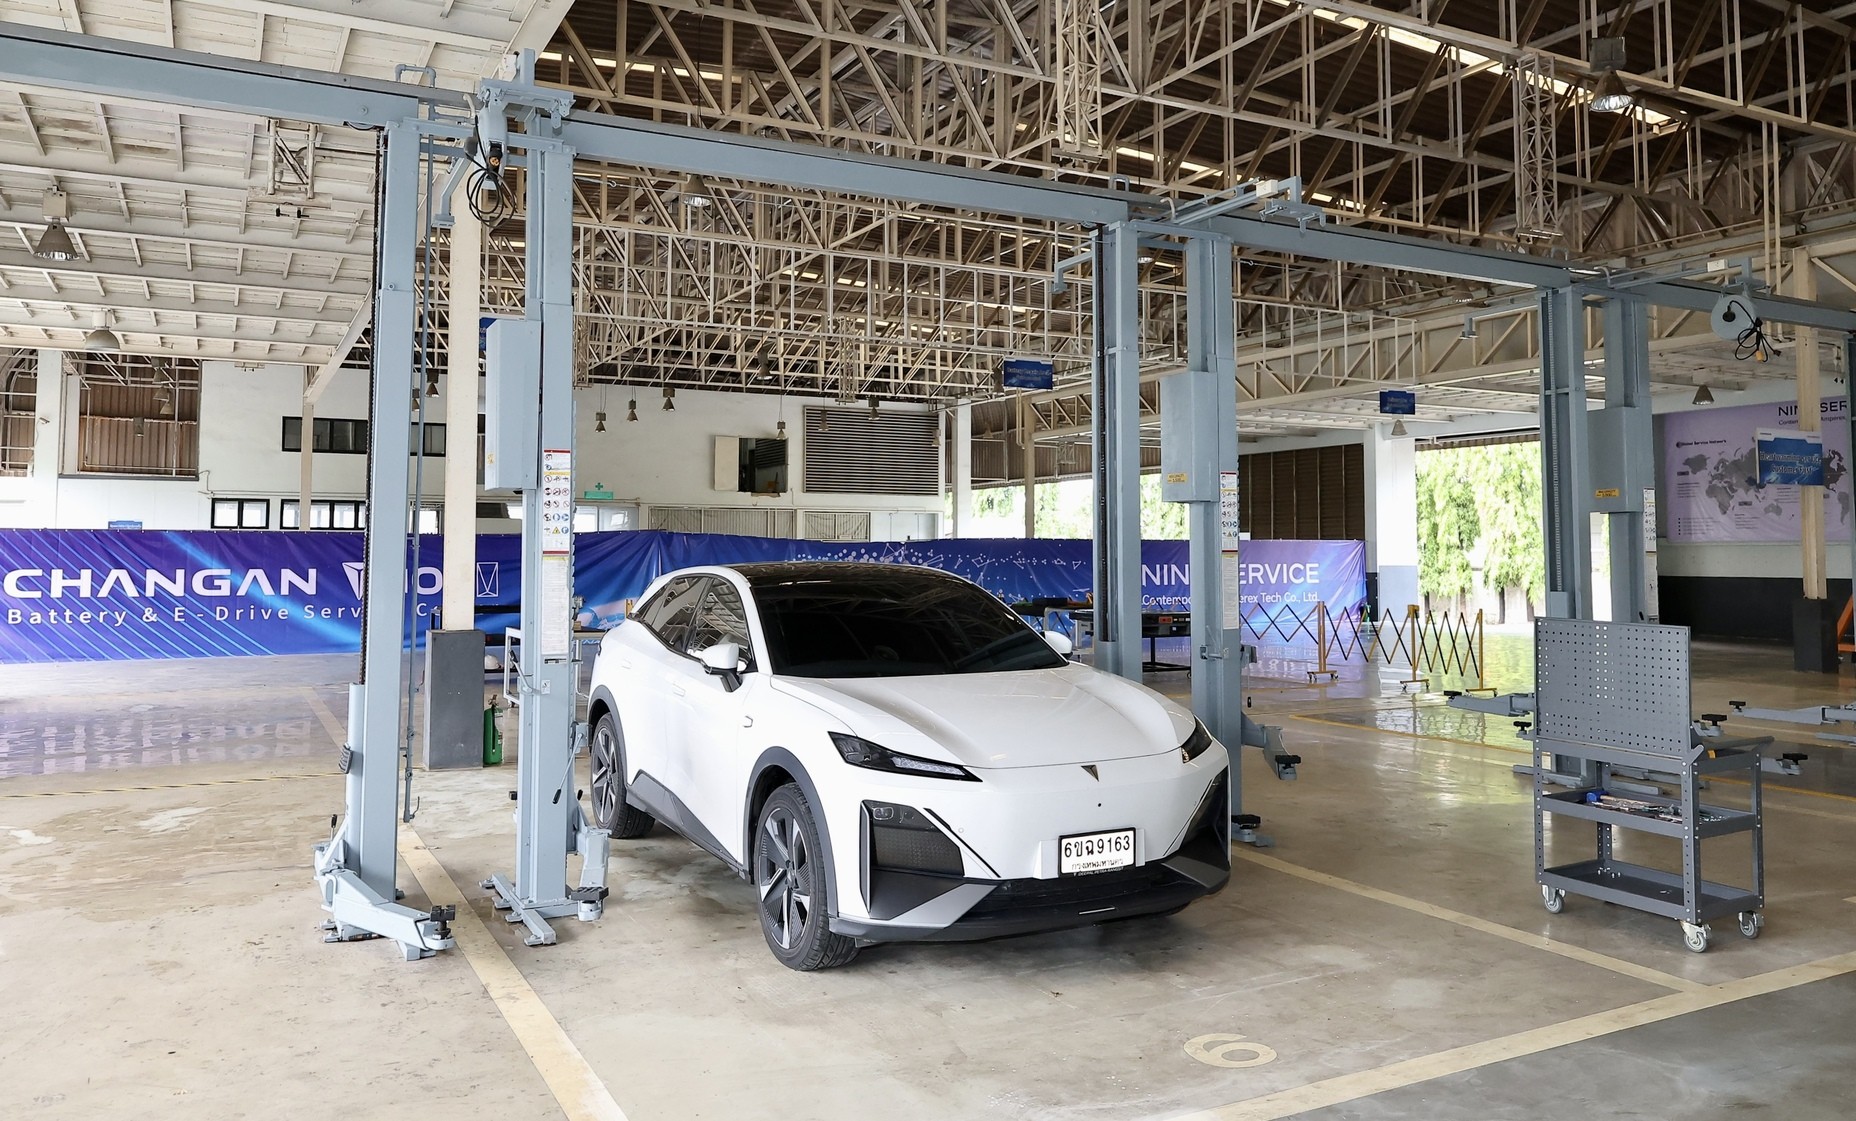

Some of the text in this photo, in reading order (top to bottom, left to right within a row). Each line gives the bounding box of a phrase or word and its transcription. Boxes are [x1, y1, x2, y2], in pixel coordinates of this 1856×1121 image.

[3, 568, 317, 599] CHANGAN
[1142, 563, 1320, 587] NIN ERVICE
[1261, 591, 1282, 604] Tech
[1303, 591, 1320, 603] Ltd.
[8, 608, 126, 627] Battery
[142, 607, 158, 622] &
[303, 604, 362, 619] Serv
[1183, 1032, 1278, 1069] 6
